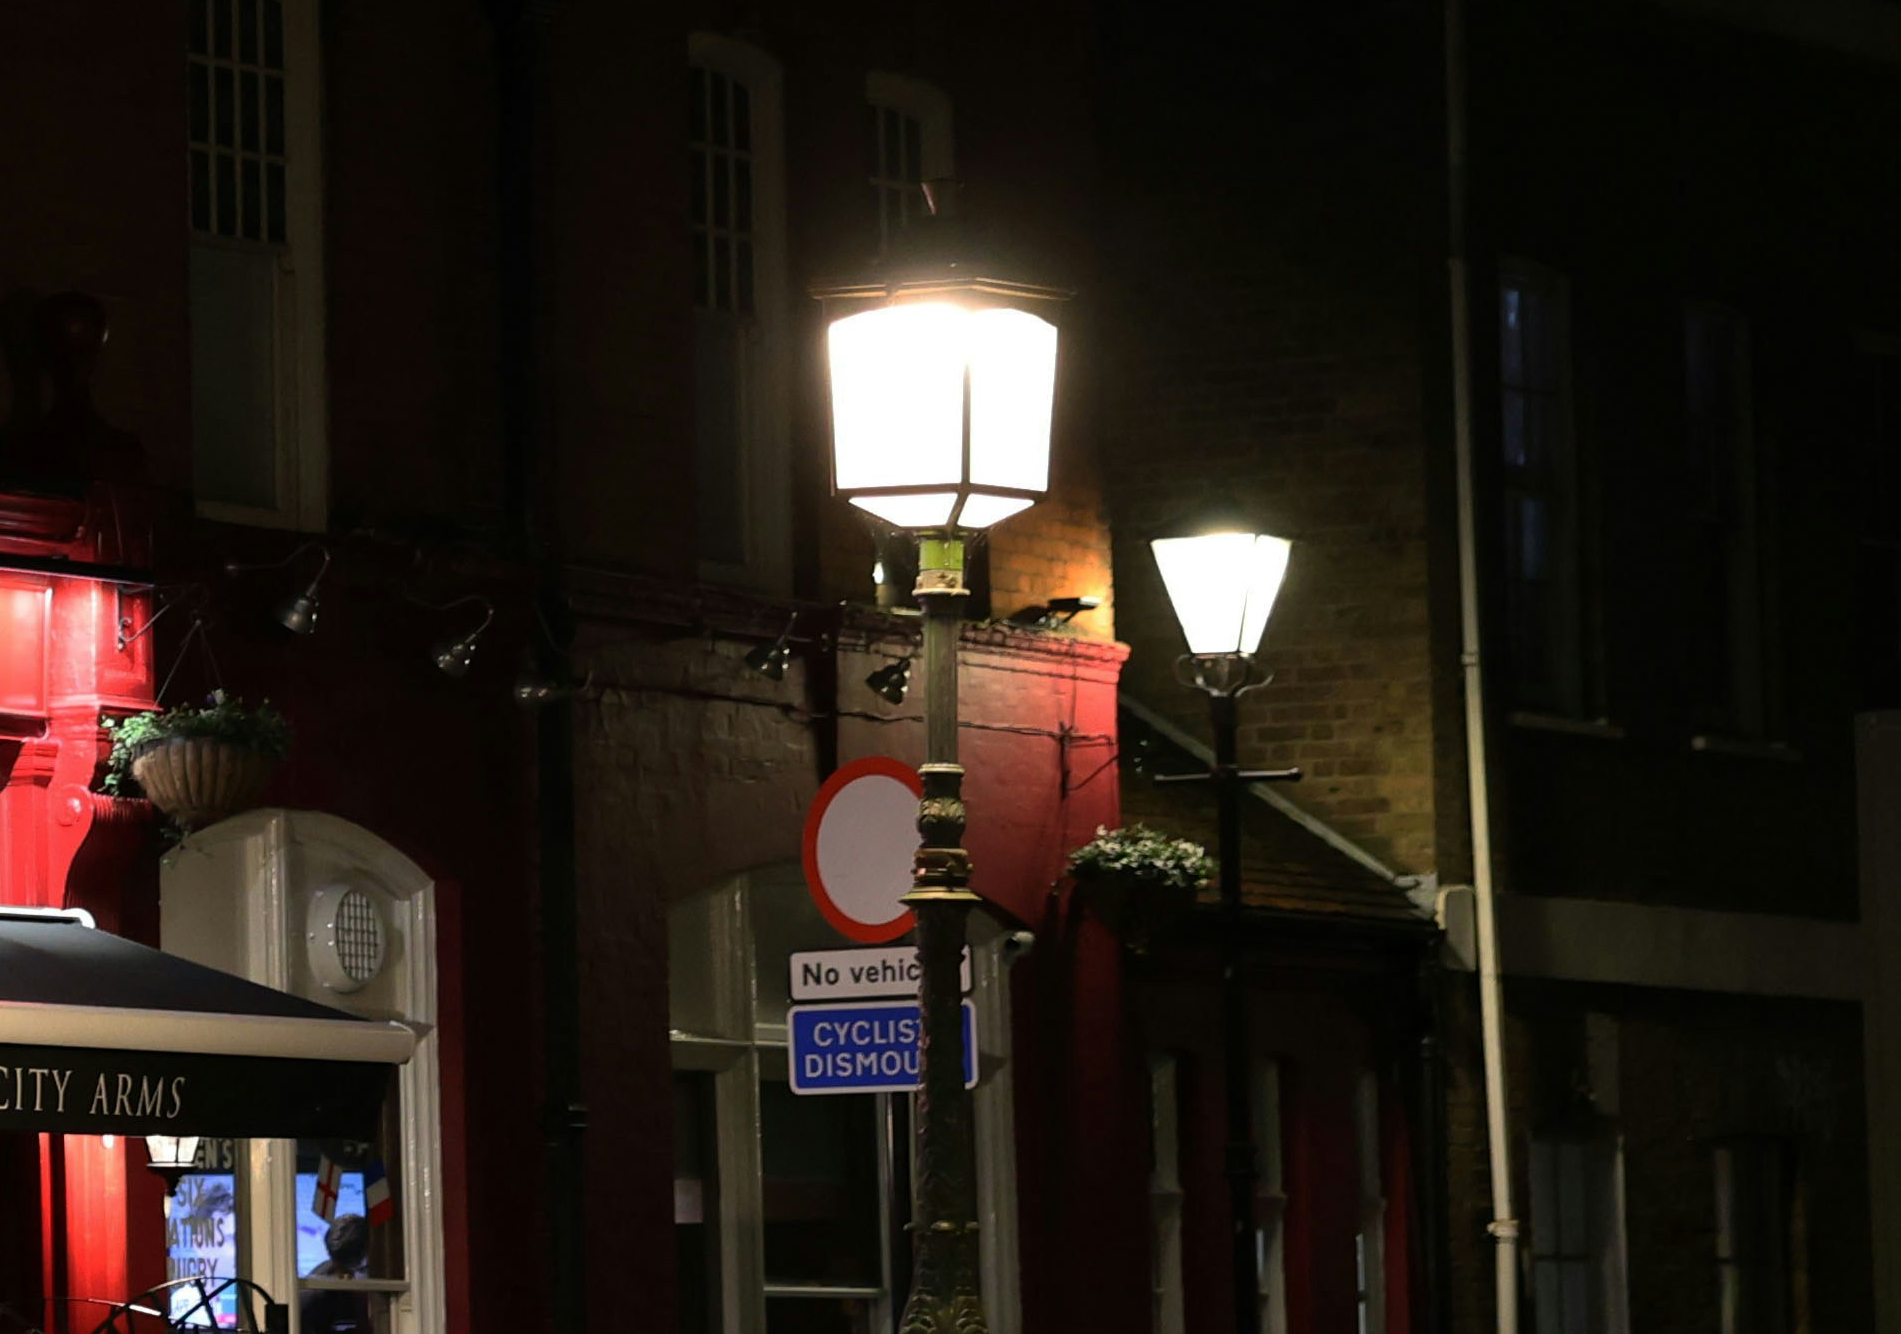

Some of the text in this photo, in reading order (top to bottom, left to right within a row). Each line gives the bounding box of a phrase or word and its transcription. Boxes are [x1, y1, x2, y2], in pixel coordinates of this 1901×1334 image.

[802, 958, 921, 986] No vehic
[813, 1019, 921, 1047] CYCLIS
[805, 1050, 920, 1078] DISMOU
[88, 1072, 186, 1120] ARMS
[176, 1177, 205, 1207] SIX
[166, 1218, 226, 1248] ATIONS
